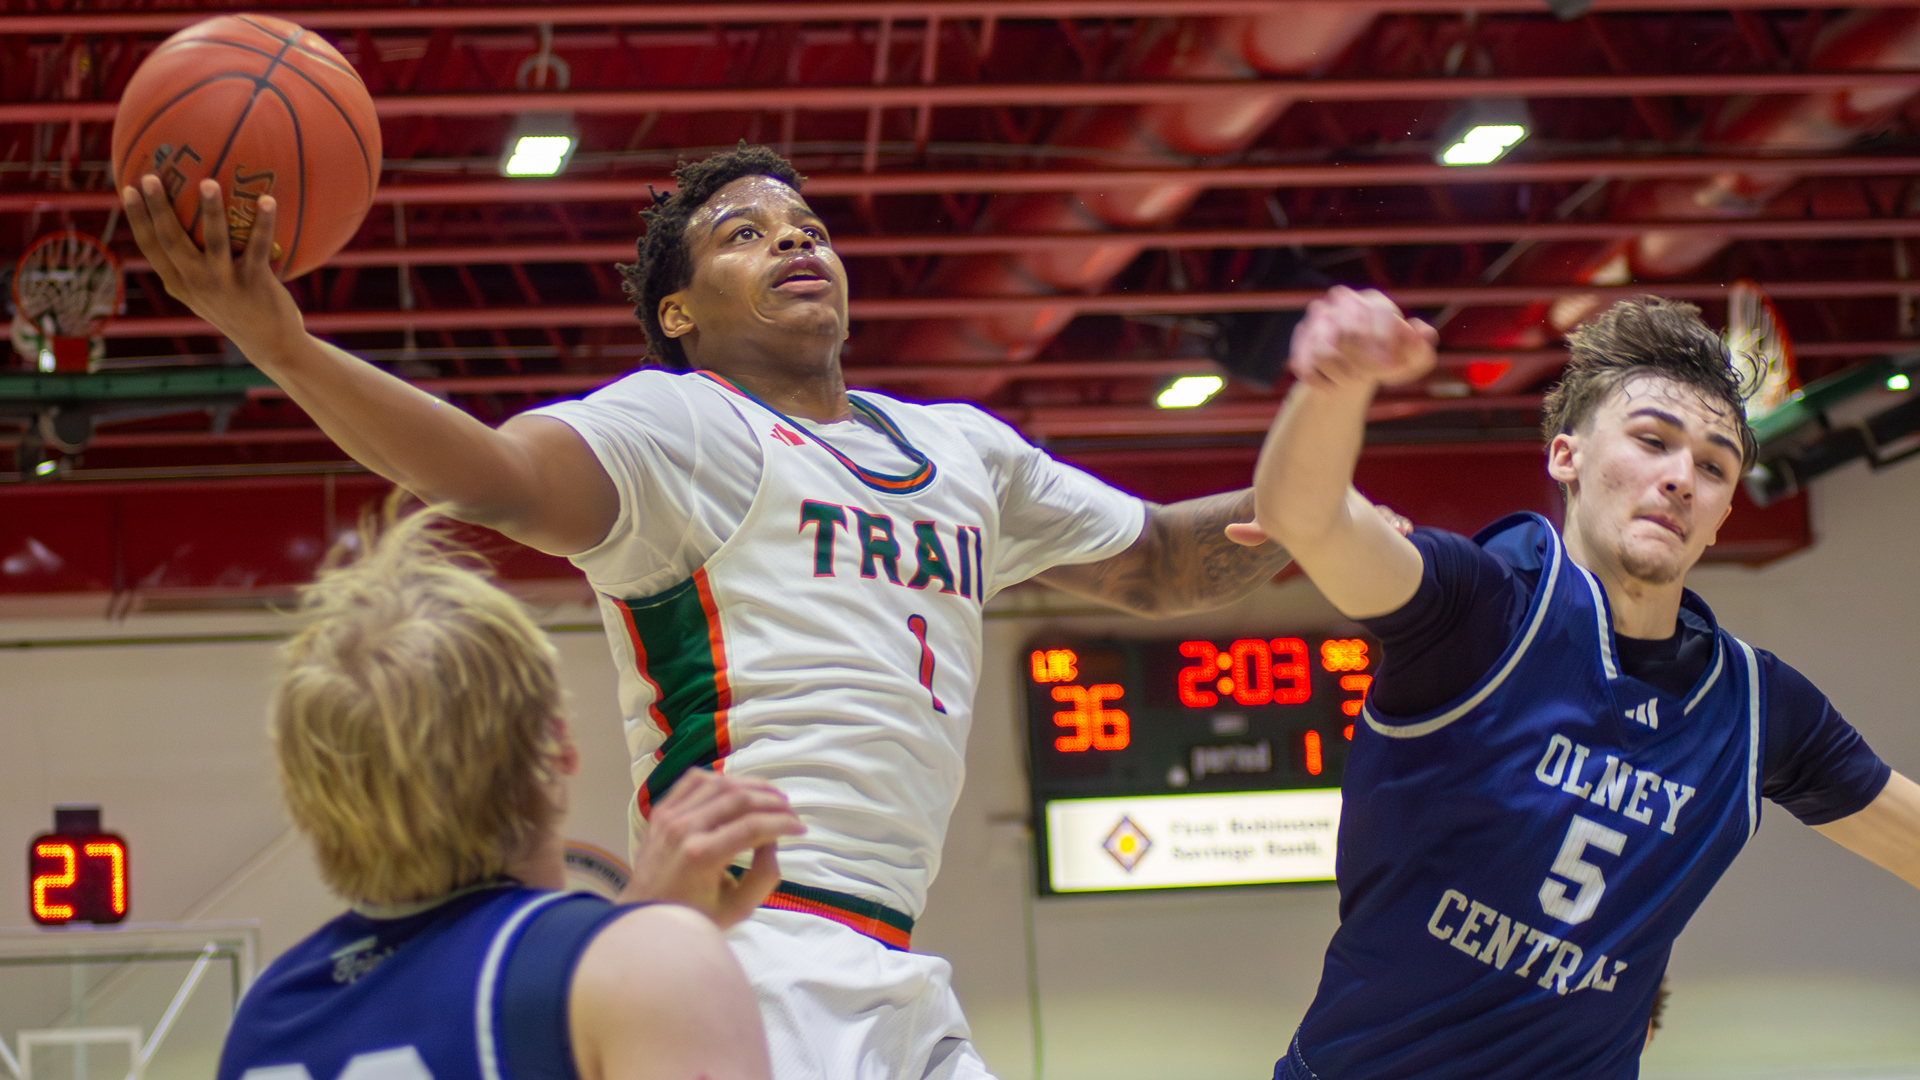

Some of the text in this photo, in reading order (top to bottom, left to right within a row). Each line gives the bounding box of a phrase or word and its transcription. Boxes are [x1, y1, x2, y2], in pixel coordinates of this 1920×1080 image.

[907, 613, 947, 715] 1
[1178, 637, 1312, 708] 2:03
[1051, 683, 1131, 753] 36
[1304, 730, 1323, 776] 1
[1535, 733, 1697, 836] OLNEY
[33, 843, 126, 919] 27
[1538, 814, 1628, 926] 5
